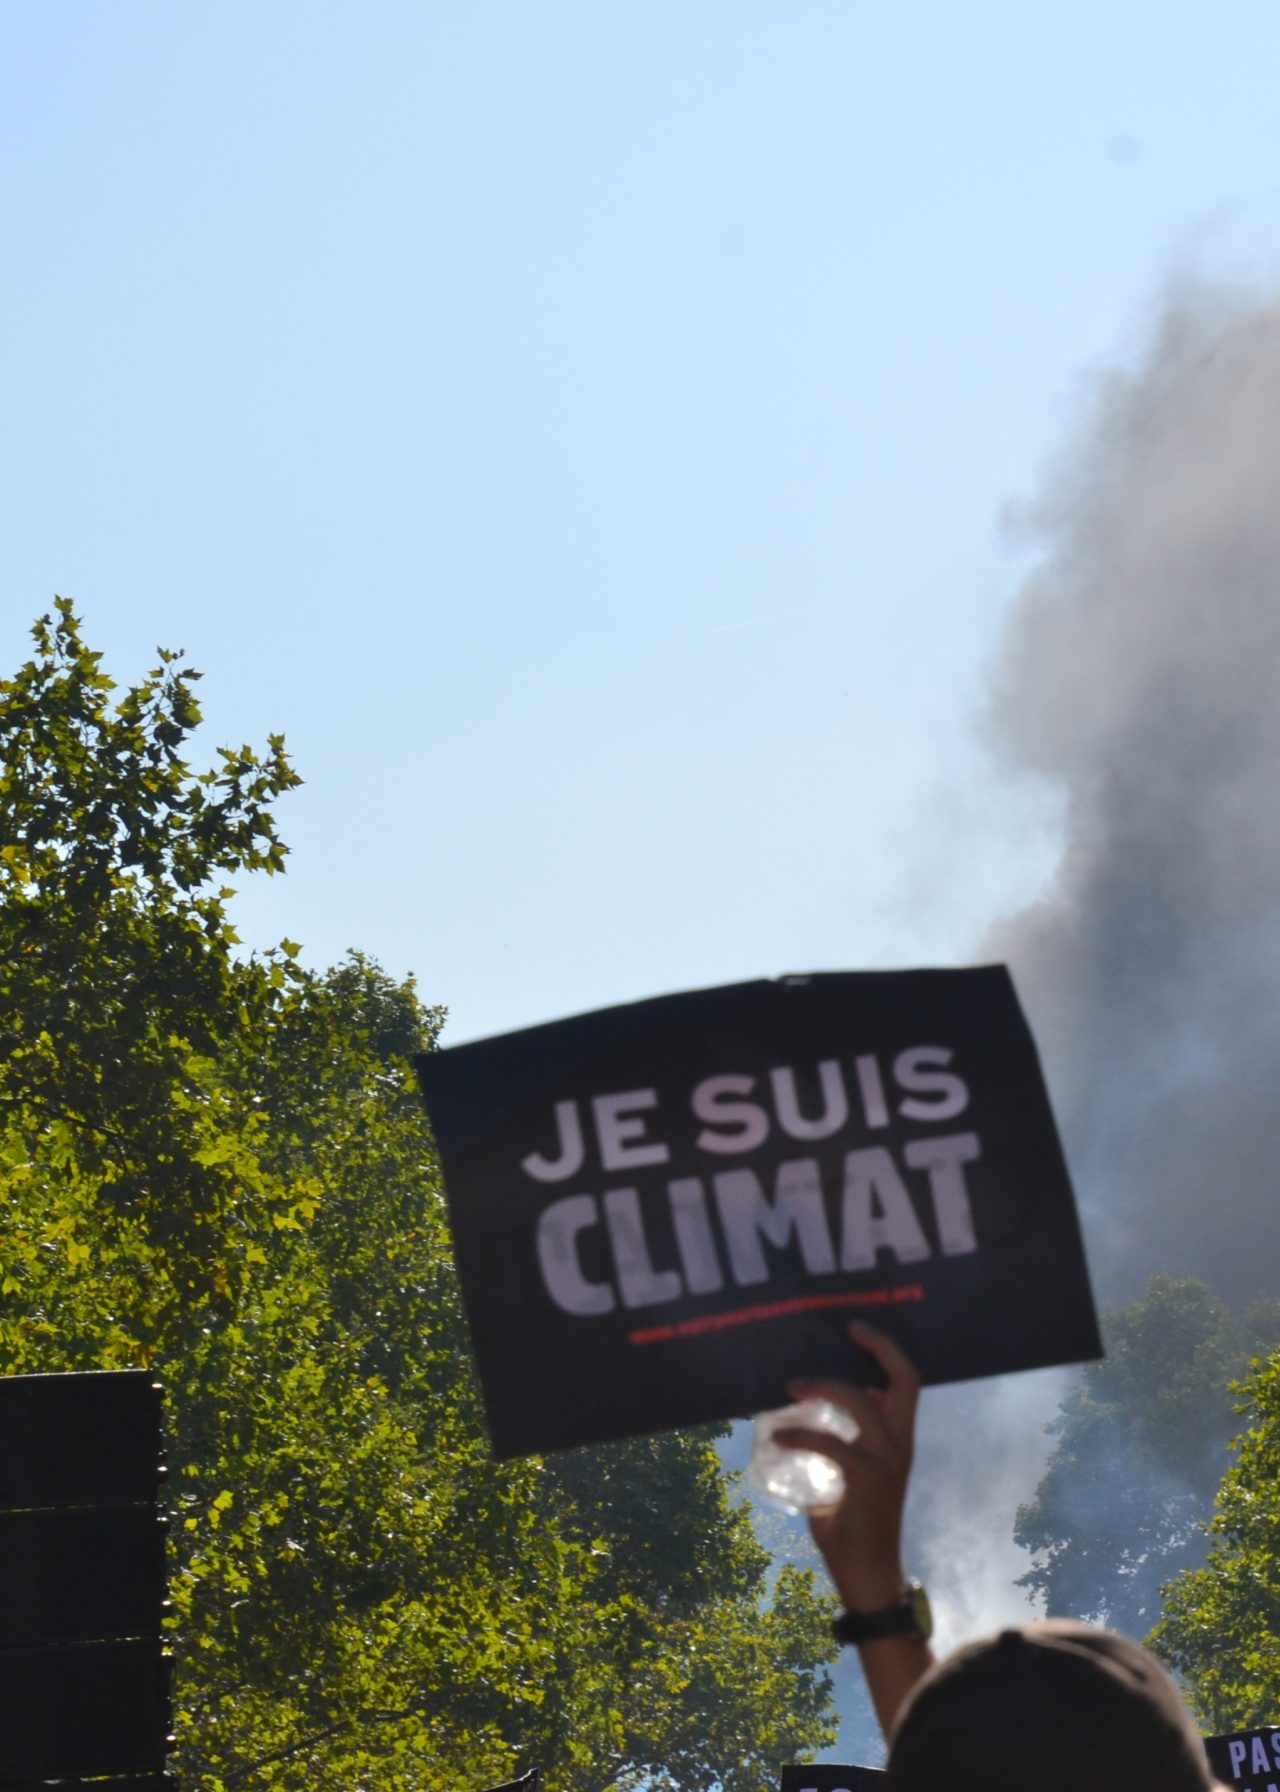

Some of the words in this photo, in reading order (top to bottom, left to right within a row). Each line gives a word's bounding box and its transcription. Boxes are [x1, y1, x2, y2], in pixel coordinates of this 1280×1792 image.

[521, 1088, 669, 1183] JE
[690, 1045, 969, 1155] SUIS
[536, 1132, 980, 1316] CLIMAT
